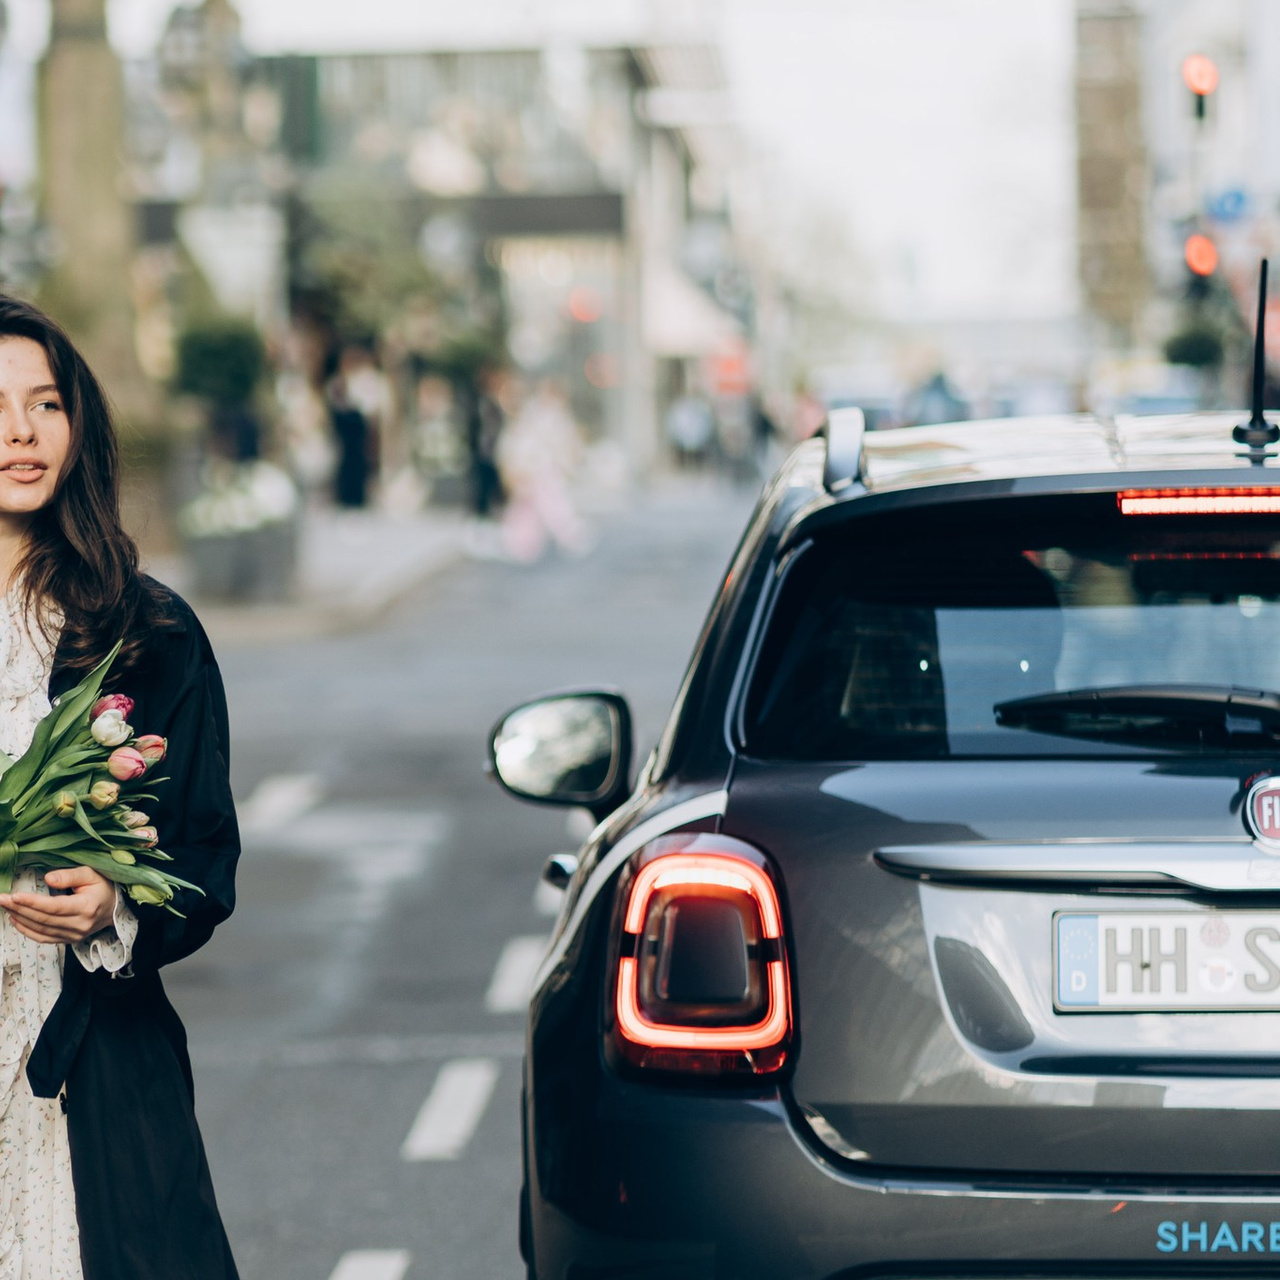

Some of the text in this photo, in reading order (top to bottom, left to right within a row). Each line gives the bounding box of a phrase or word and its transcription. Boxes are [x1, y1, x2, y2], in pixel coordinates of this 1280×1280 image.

[1105, 926, 1280, 993] HH S
[1070, 969, 1087, 992] D
[1156, 1220, 1280, 1253] SHARE
